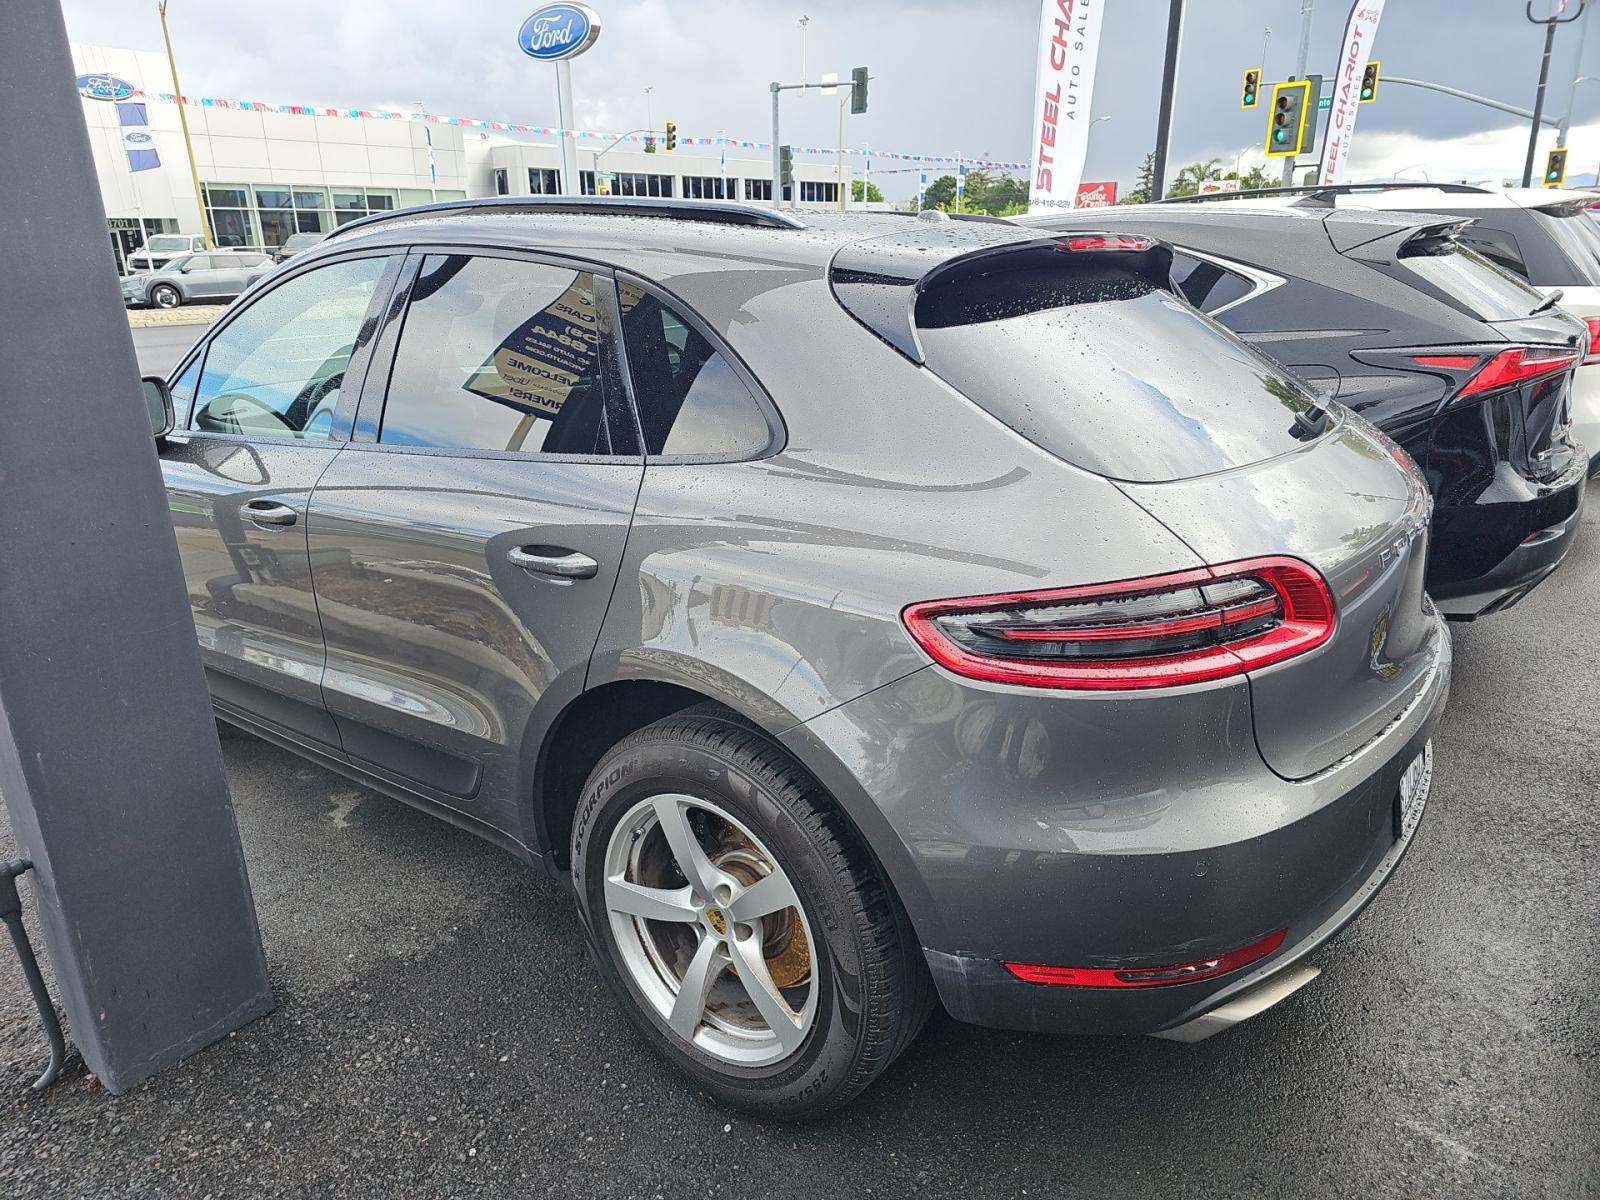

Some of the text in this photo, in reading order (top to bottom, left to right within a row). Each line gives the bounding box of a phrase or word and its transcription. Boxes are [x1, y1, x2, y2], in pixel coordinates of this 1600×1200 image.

[531, 15, 573, 50] Ford
[1067, 65, 1081, 120] AUTO
[1324, 24, 1363, 186] TEEL CHARIOT
[1342, 76, 1361, 157] AUTO SALES
[1036, 83, 1061, 193] STEEL
[575, 760, 634, 856] SCORPION
